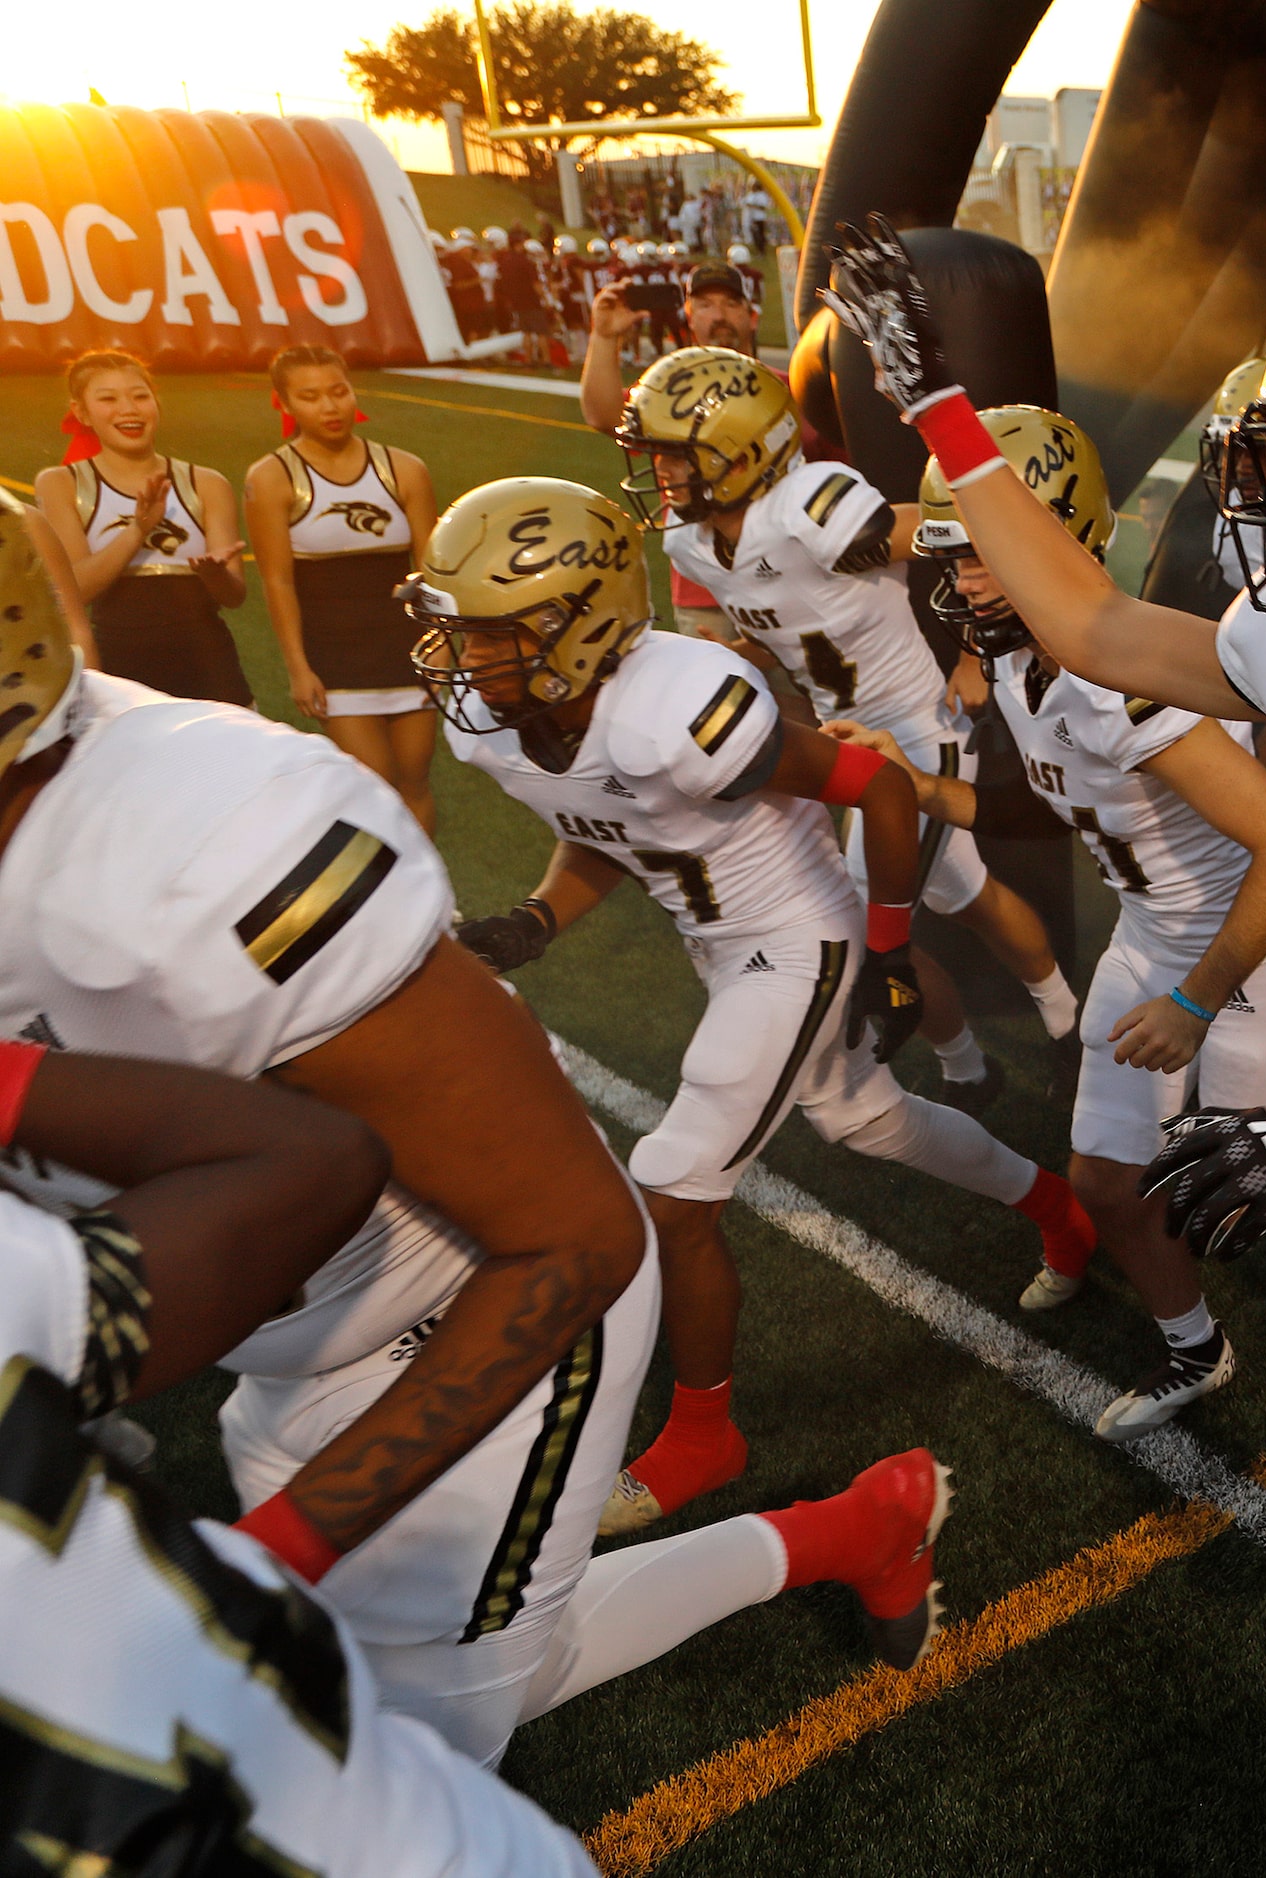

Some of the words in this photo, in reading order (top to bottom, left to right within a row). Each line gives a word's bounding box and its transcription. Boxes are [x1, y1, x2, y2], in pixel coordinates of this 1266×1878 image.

[666, 368, 762, 420] East
[1024, 427, 1075, 490] ast
[508, 515, 631, 576] East
[926, 526, 952, 537] PESH
[555, 812, 631, 844] EAST
